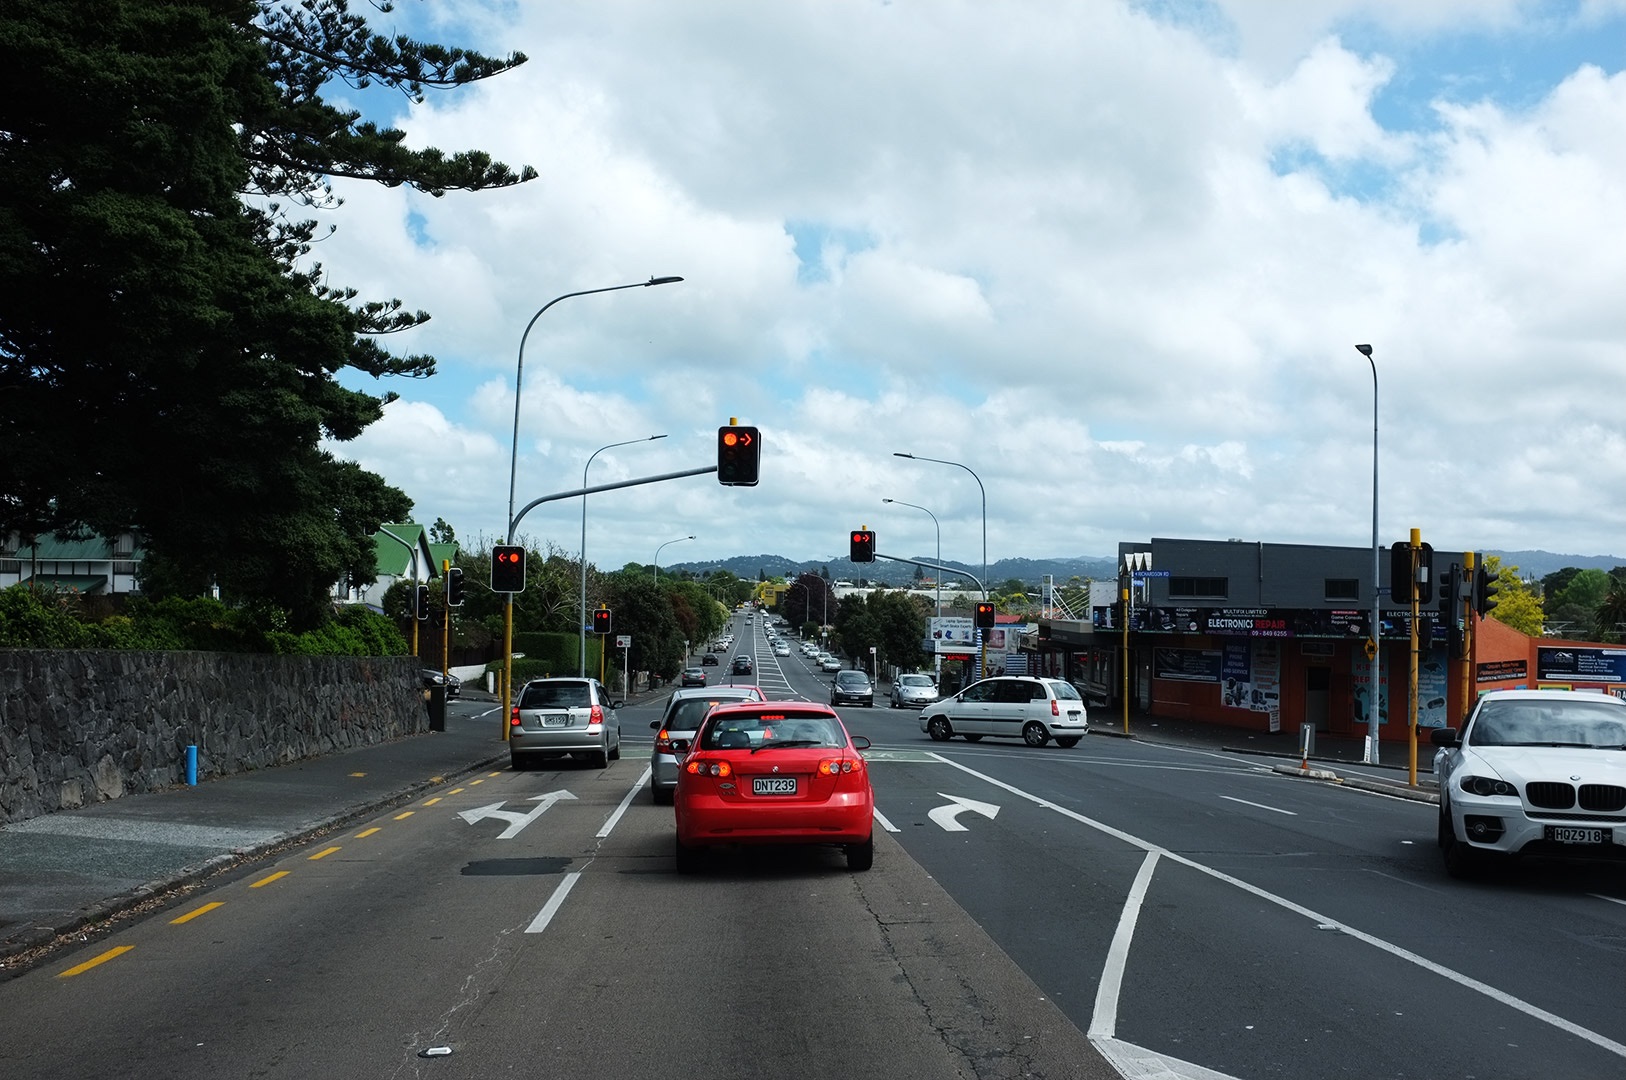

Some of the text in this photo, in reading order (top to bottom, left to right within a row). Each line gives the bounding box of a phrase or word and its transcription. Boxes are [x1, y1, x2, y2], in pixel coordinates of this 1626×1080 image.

[1208, 619, 1286, 629] ELECTRONICS REPAIR
[1356, 664, 1385, 672] X-BX
[1352, 675, 1387, 684] REPIR
[755, 780, 795, 791] DNT239
[1556, 829, 1601, 842] HQZ918
